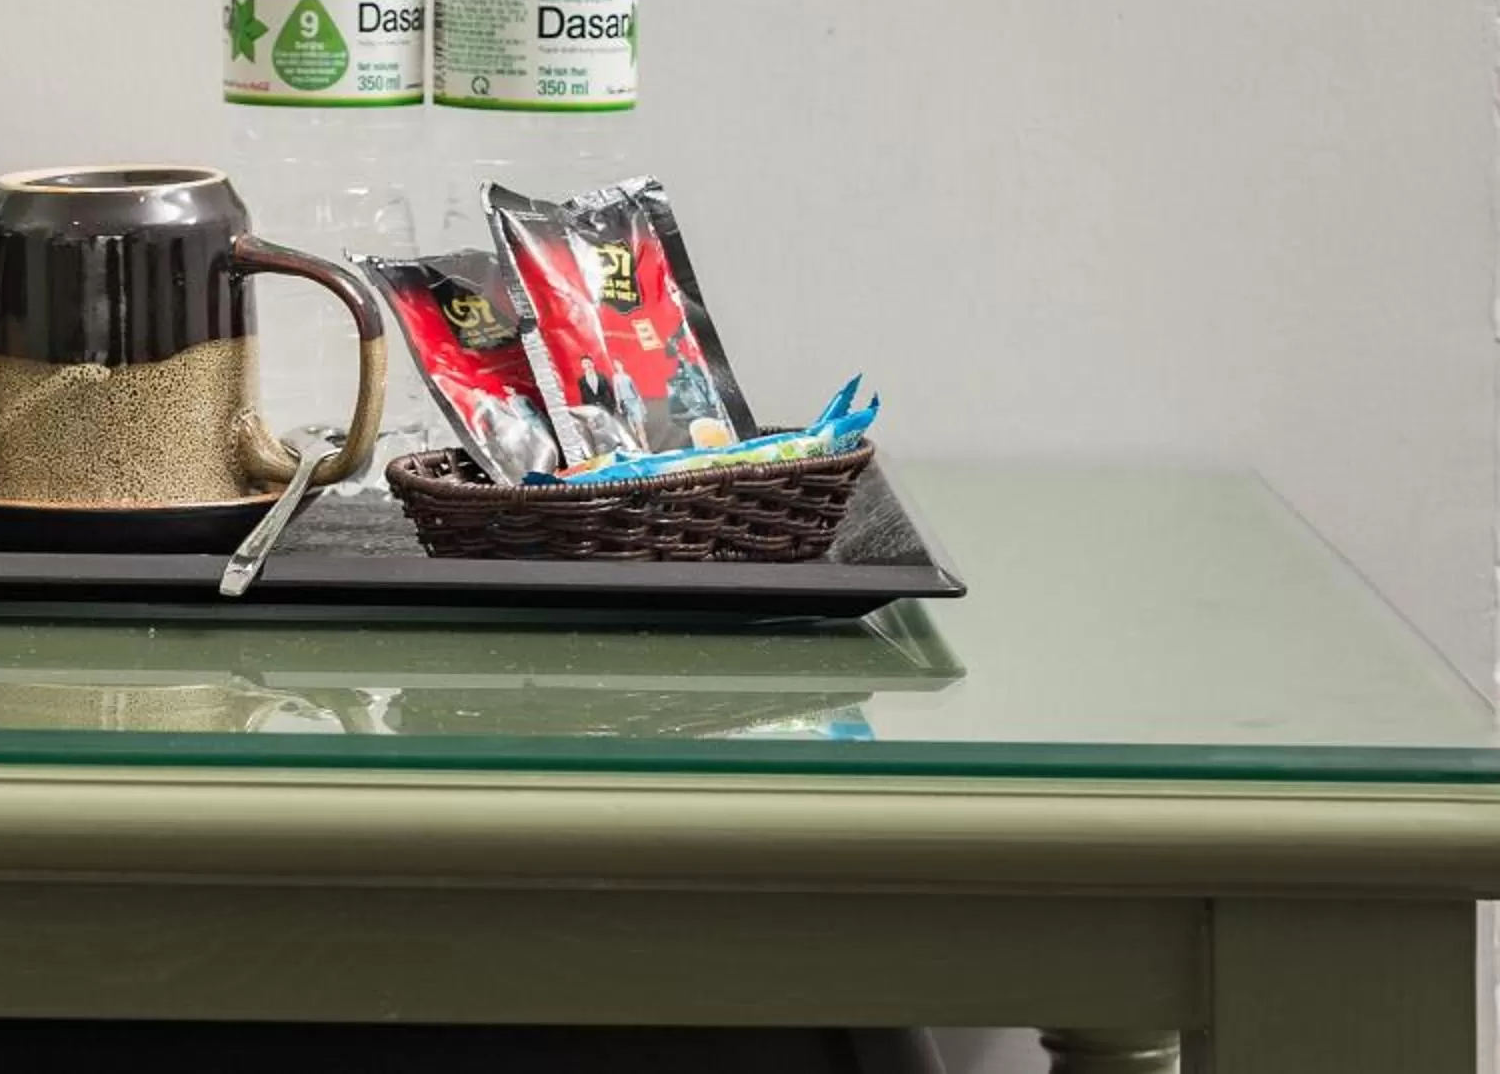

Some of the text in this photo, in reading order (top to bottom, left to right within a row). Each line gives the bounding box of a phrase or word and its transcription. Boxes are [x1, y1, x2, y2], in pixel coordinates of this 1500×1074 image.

[299, 10, 319, 38] 9
[358, 75, 383, 91] 350
[537, 79, 566, 96] 350
[571, 79, 588, 95] ml
